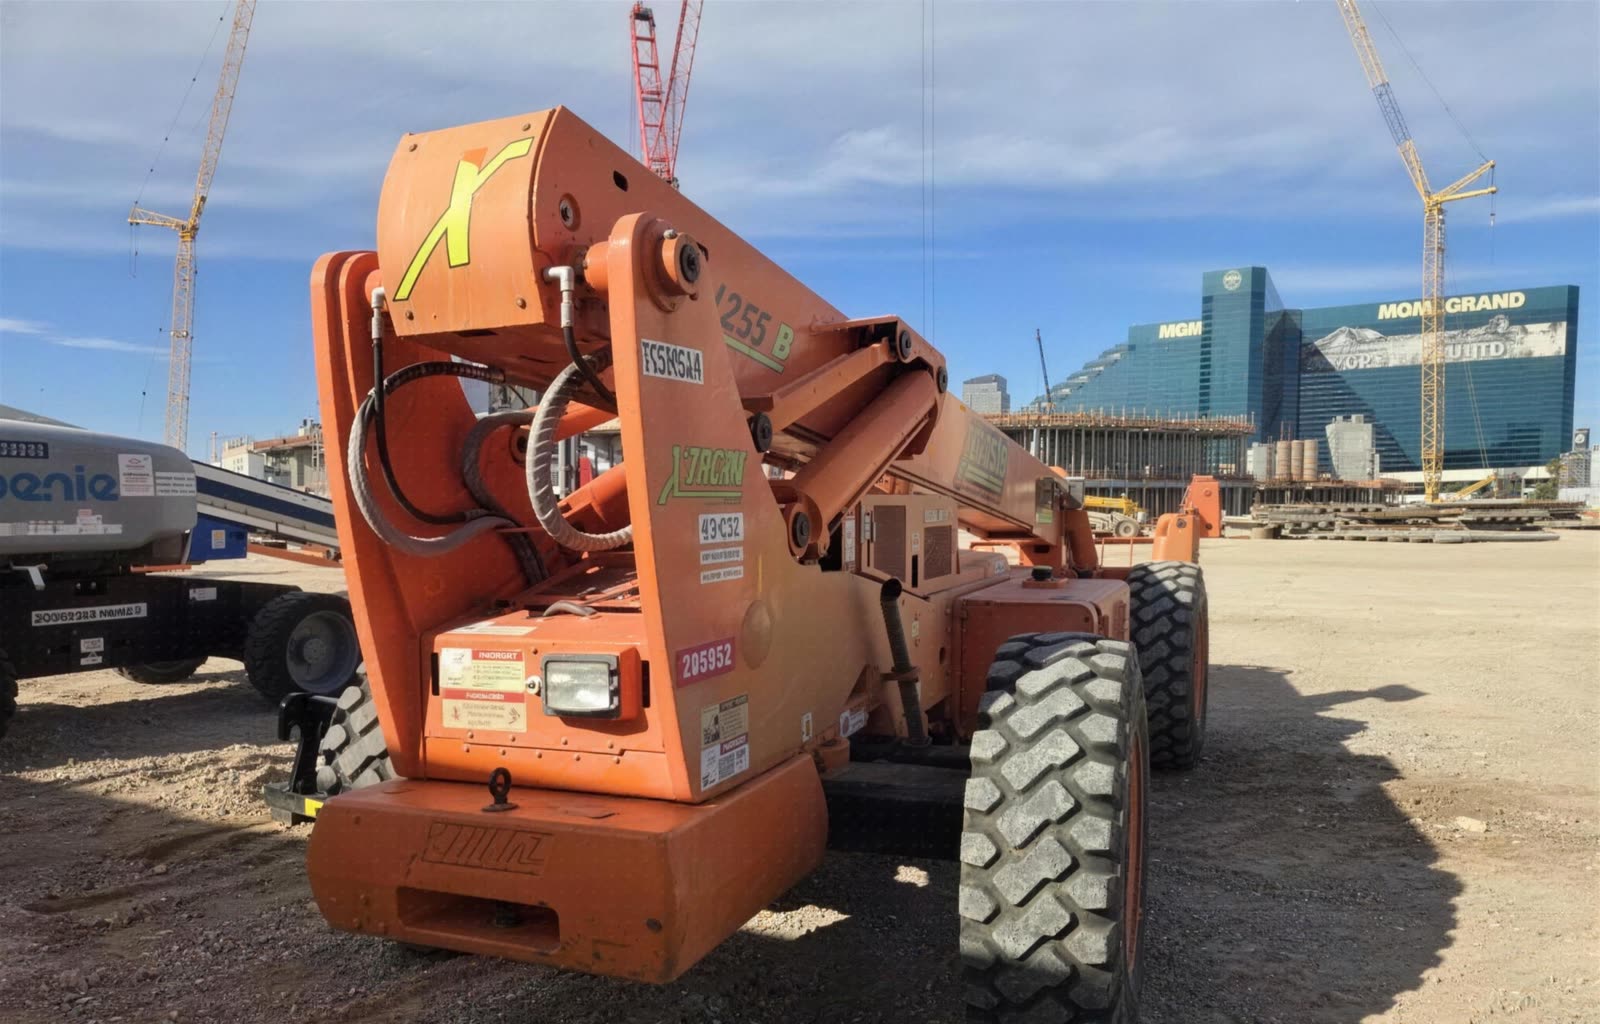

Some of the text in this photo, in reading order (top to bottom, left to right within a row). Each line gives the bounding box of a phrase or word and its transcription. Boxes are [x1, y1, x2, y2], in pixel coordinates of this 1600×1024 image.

[1445, 291, 1526, 313] GRAND
[1159, 320, 1203, 339] MGM
[0, 465, 119, 502] enie
[683, 643, 732, 679] 205952
